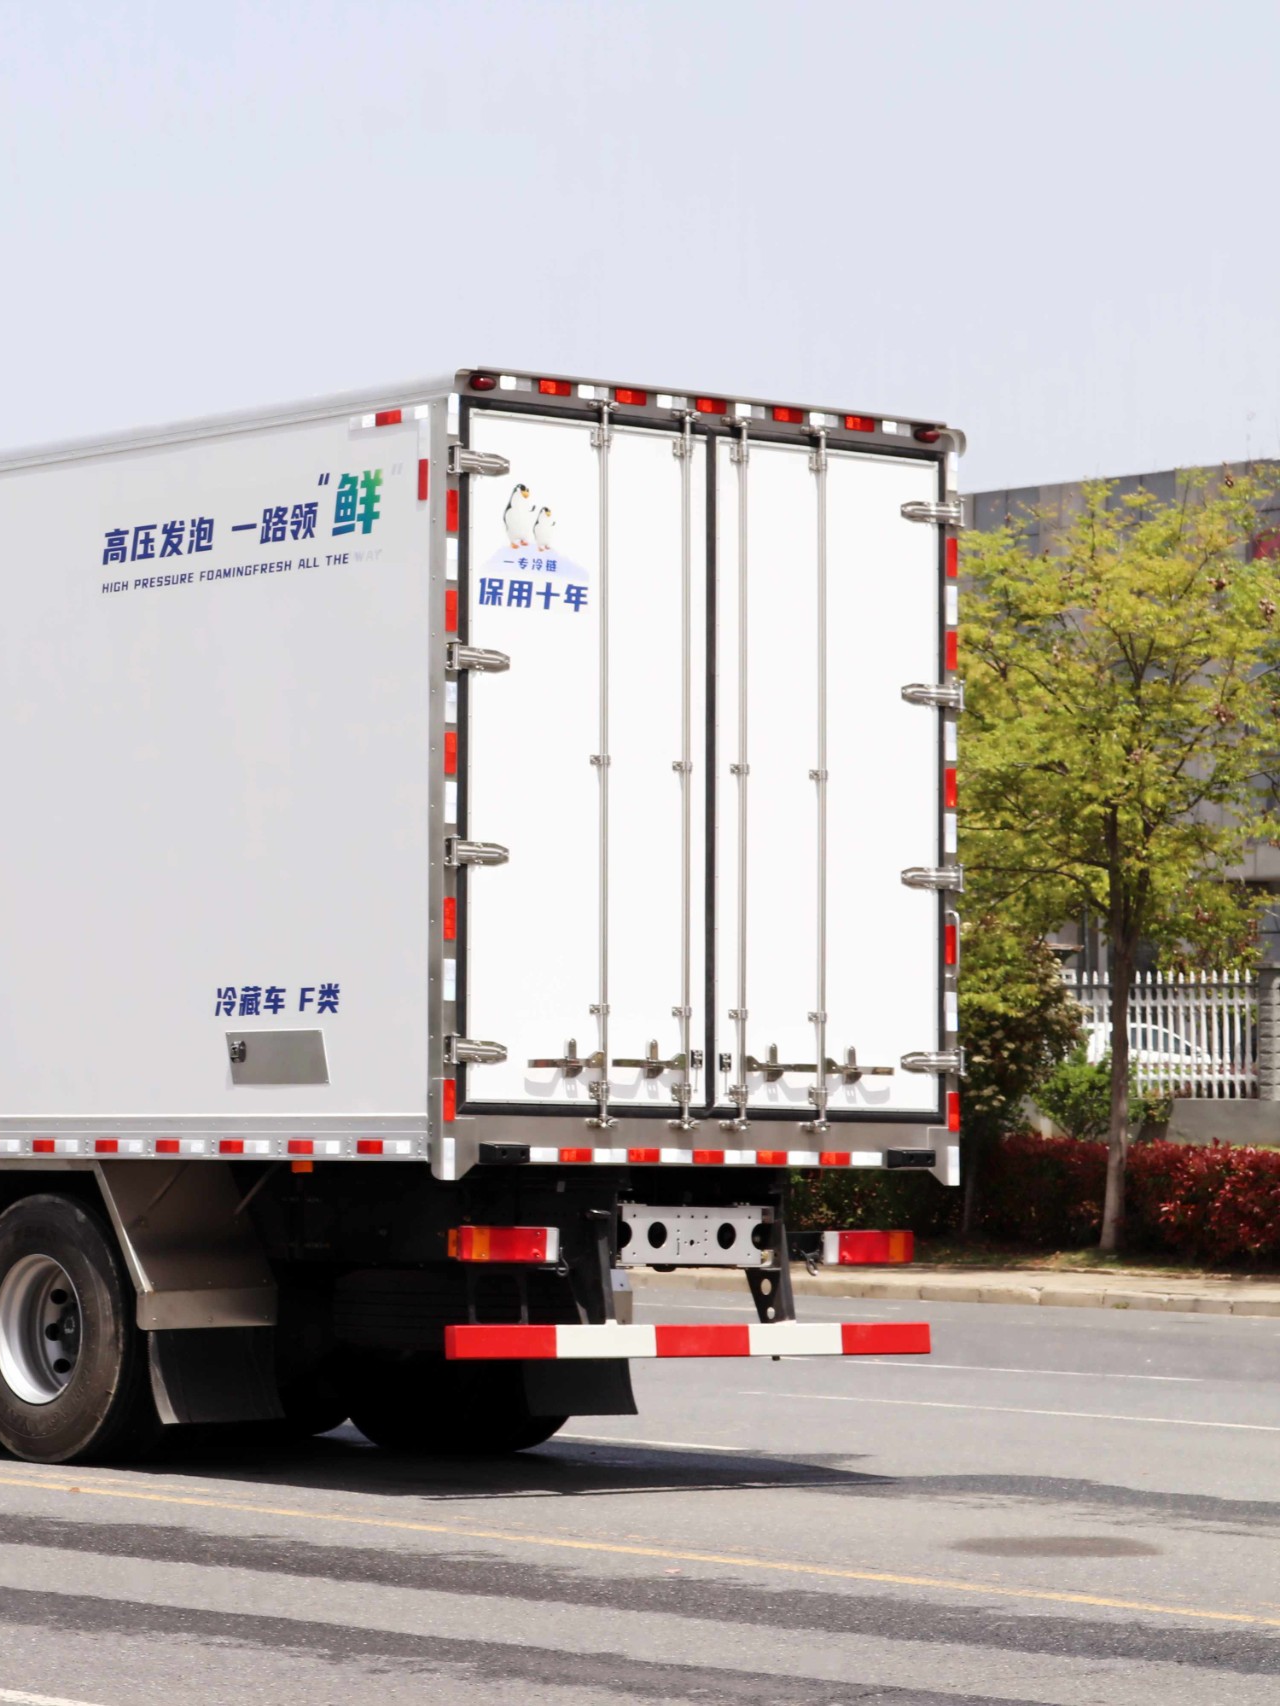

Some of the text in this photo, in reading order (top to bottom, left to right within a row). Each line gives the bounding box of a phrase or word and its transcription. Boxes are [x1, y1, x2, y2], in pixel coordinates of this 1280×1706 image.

[102, 516, 215, 566] 高压发泡
[101, 580, 129, 594] HIGH
[133, 572, 195, 590] PRESSURE
[199, 560, 293, 583] FOAMINGFRESH
[297, 556, 320, 570] ALL
[325, 552, 350, 566] THE
[503, 557, 558, 573] 一专冷链
[478, 577, 589, 613] 保用十年
[214, 983, 341, 1017] 冷藏车 F类
